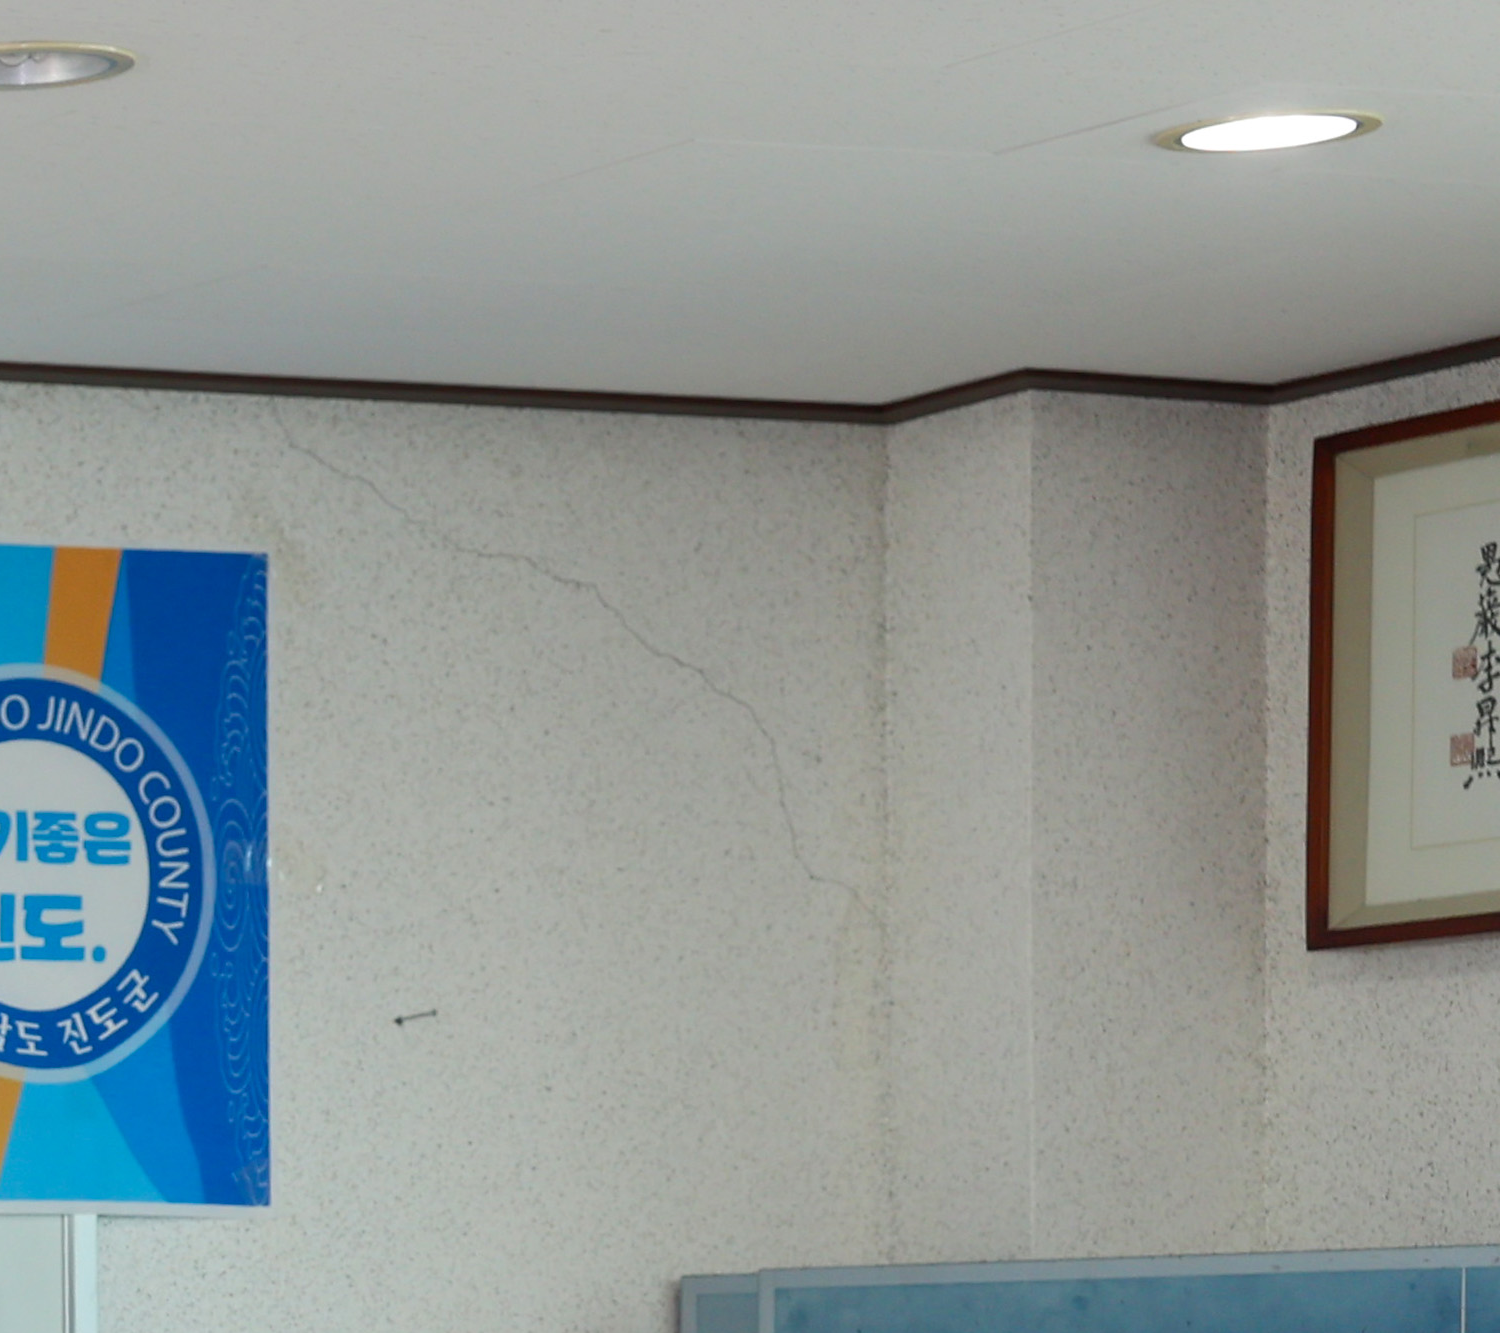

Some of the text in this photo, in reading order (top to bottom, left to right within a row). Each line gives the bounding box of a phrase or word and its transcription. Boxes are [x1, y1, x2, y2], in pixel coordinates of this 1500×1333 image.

[37, 695, 145, 773] JINDO
[138, 771, 190, 946] COUNTY
[56, 968, 160, 1056] 진도군
